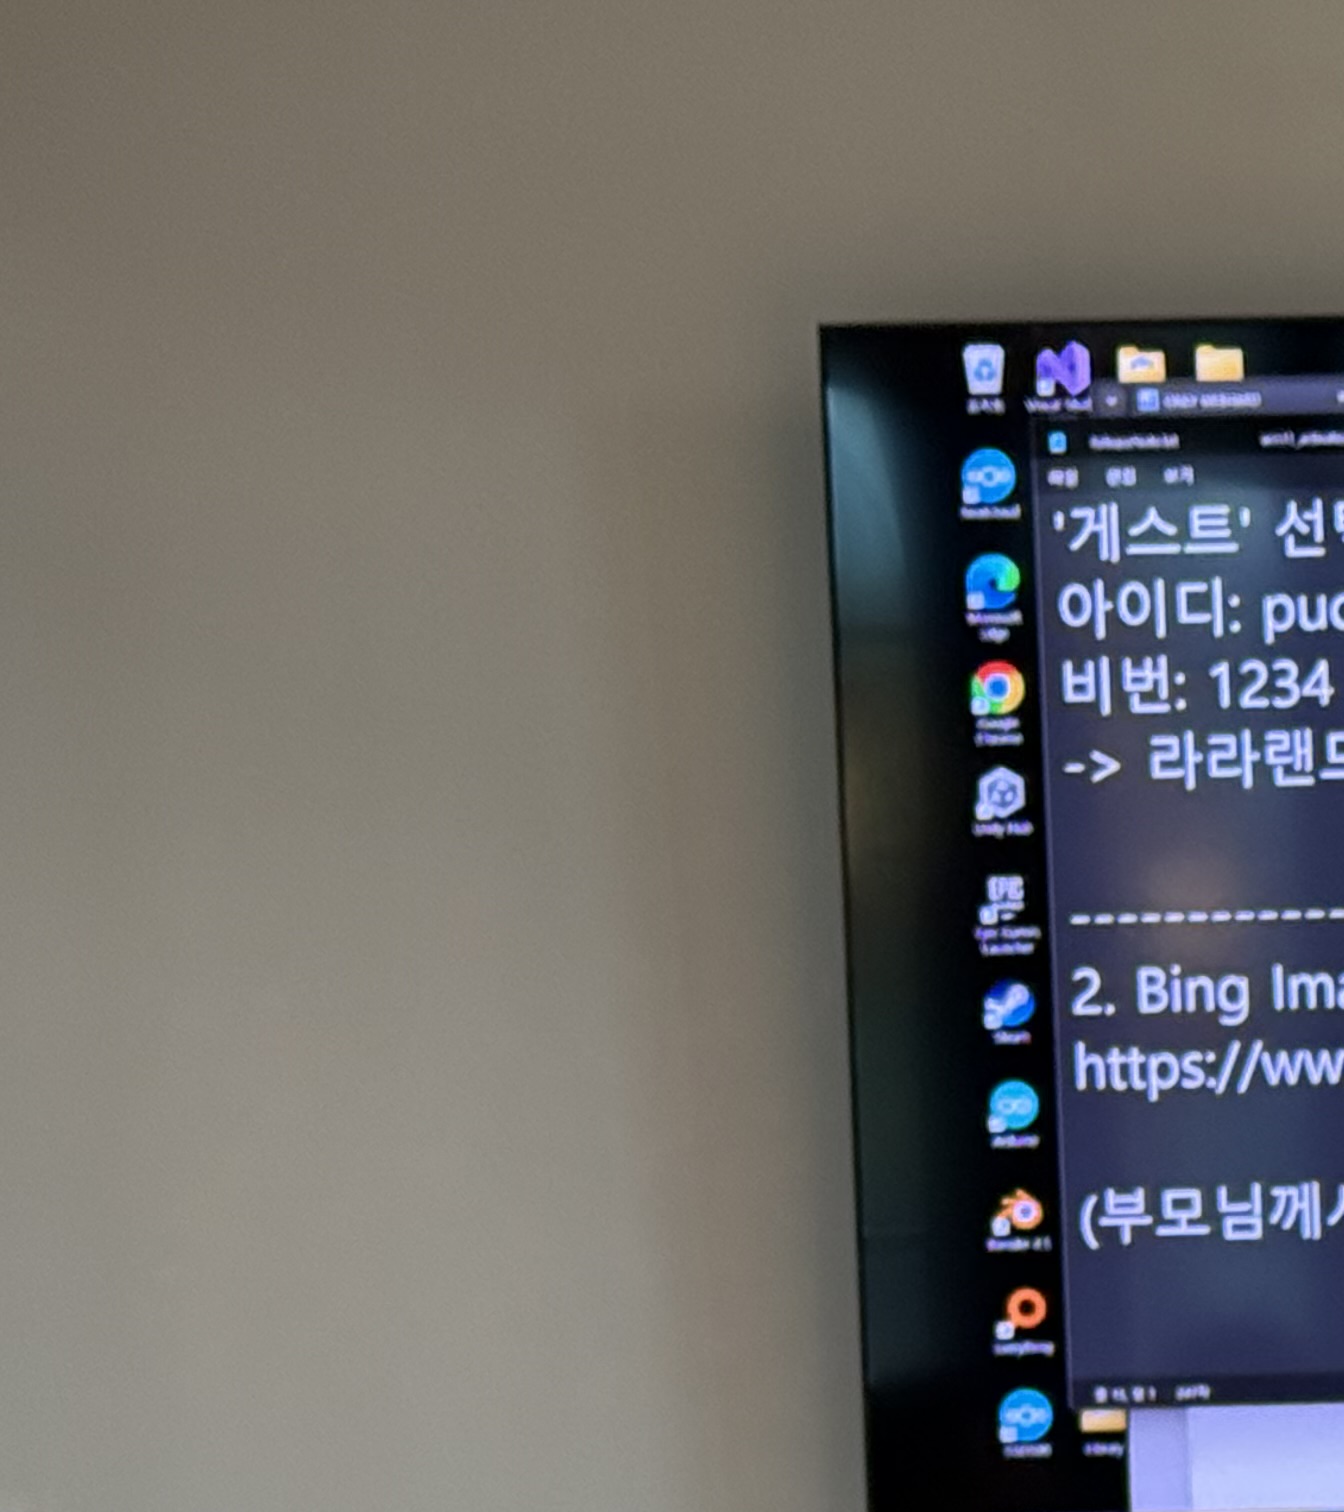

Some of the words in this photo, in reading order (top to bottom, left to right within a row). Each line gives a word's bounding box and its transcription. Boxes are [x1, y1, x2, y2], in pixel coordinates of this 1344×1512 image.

[1052, 501, 1251, 563] '게스트'
[1058, 576, 1242, 641] 아이디:
[1060, 654, 1187, 717] 비번:
[1208, 657, 1335, 709] 1234
[1070, 967, 1116, 1017] 2.
[1135, 964, 1250, 1026] Bing
